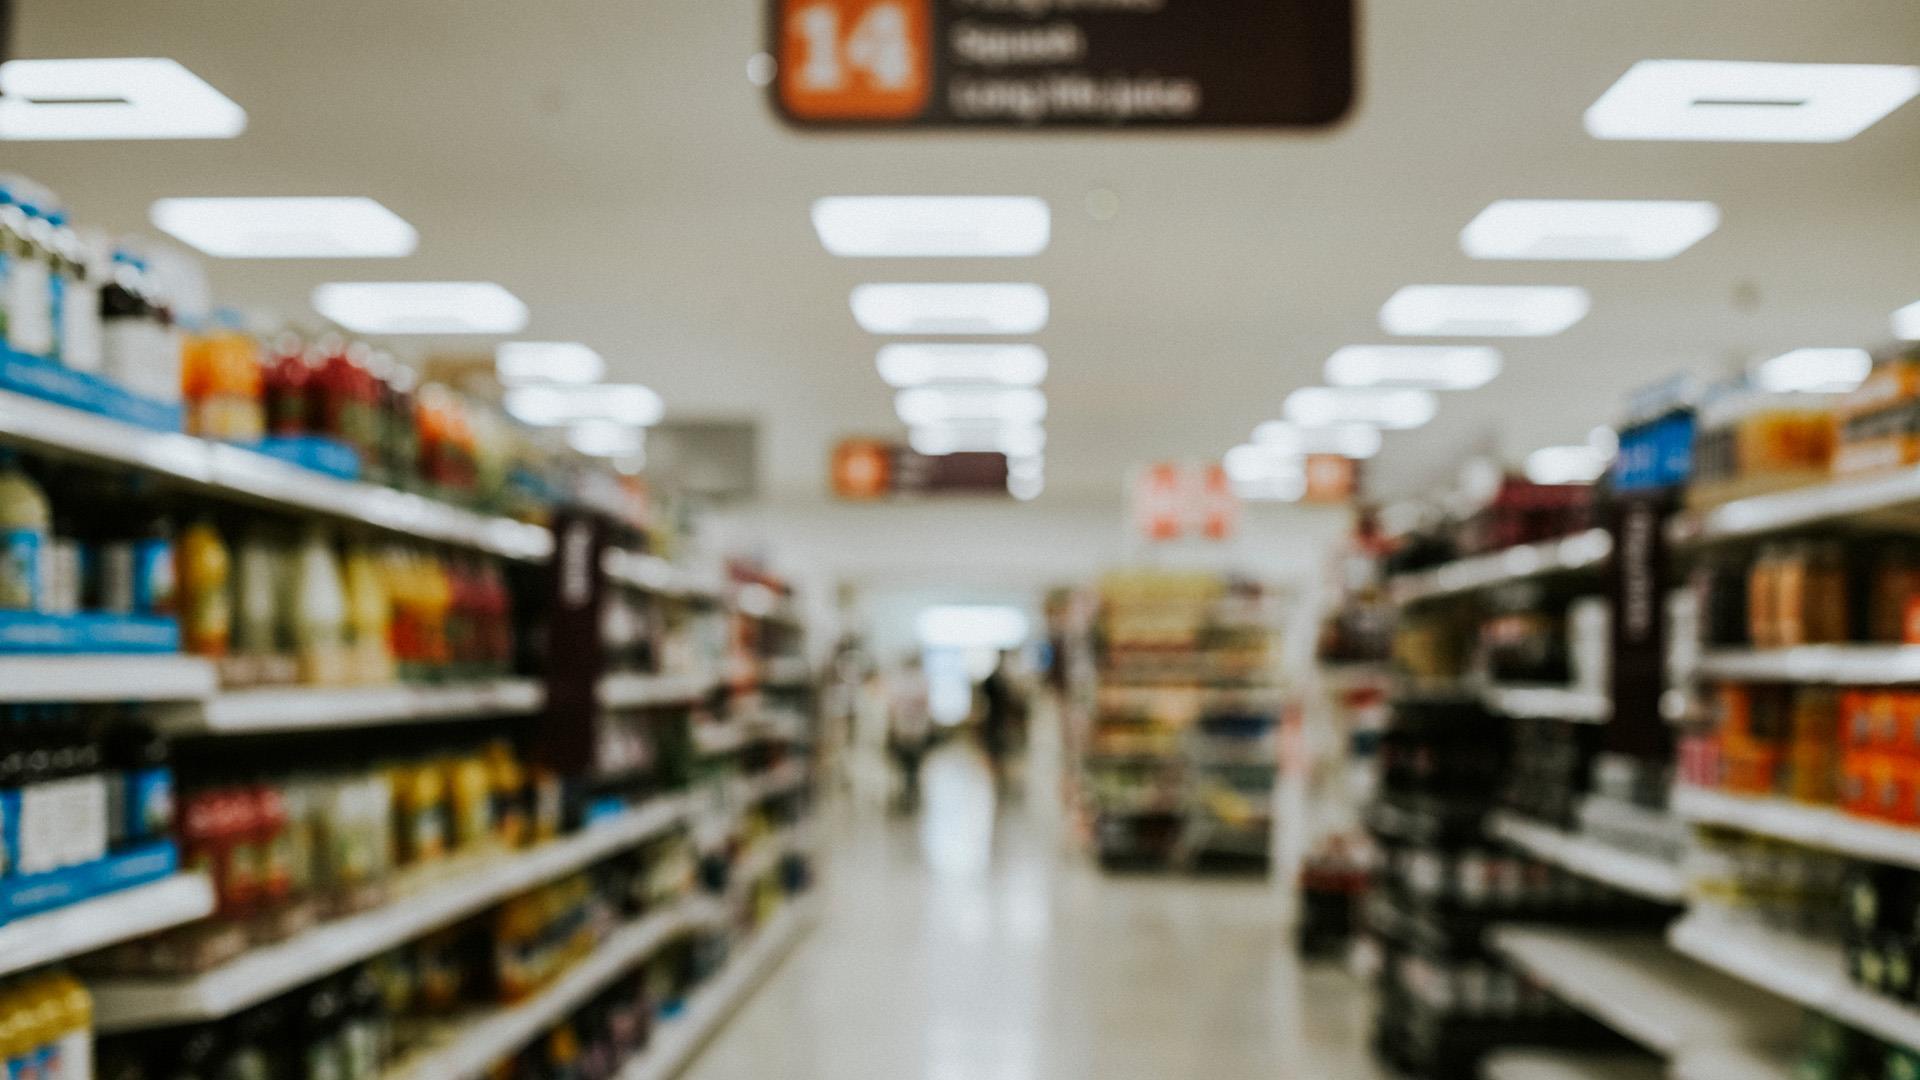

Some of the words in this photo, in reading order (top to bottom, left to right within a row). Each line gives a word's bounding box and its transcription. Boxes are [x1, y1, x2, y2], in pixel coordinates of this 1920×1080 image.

[784, 4, 915, 90] 14
[953, 24, 1085, 65] Squash
[951, 78, 1045, 119] Long
[1105, 77, 1199, 118] juice
